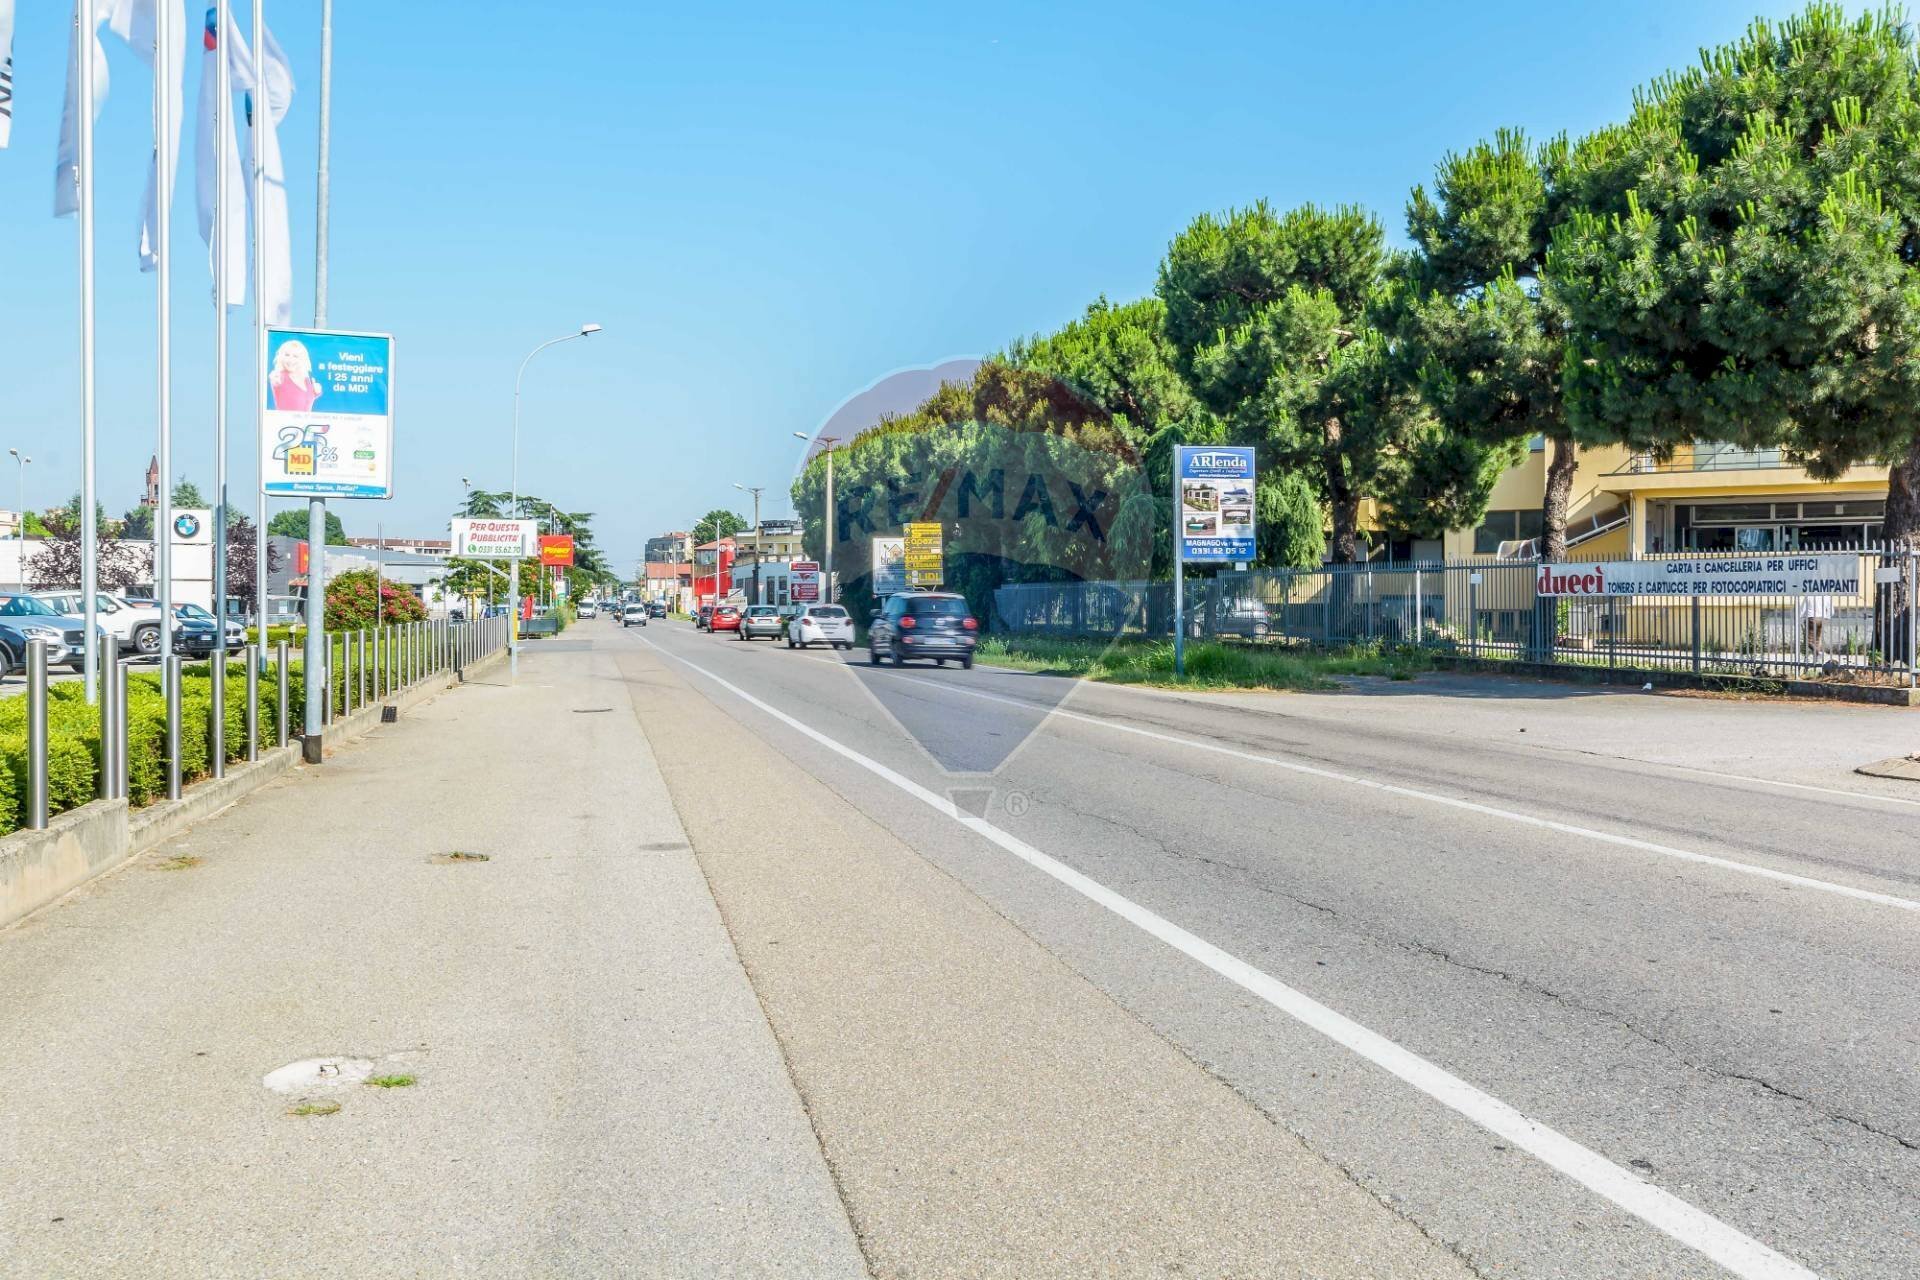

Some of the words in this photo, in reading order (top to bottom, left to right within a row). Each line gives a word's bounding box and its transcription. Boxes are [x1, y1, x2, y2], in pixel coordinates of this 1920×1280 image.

[338, 352, 364, 362] Vieni
[328, 362, 384, 374] festeggiare
[334, 373, 348, 382] 25
[351, 374, 374, 383] anni
[333, 383, 346, 392] da
[348, 384, 368, 393] MD!
[290, 454, 311, 464] MD
[1189, 452, 1247, 468] ARTenda
[488, 522, 520, 532] QUESTA
[1666, 562, 1693, 574] CARTA
[1696, 562, 1701, 573] E
[1704, 560, 1762, 573] CANCELLERIA
[1767, 560, 1784, 572] PER
[1788, 558, 1818, 571] UFFICI
[919, 572, 940, 581] LIDL
[1538, 565, 1604, 595] duecì
[1607, 582, 1635, 594] TONERS
[1638, 582, 1642, 593] E
[1646, 582, 1688, 594] CARTUCCE
[1693, 582, 1708, 594] PER
[1711, 580, 1786, 593] FOTOCOPIATRICI
[1802, 579, 1858, 593] STAMPANTI
